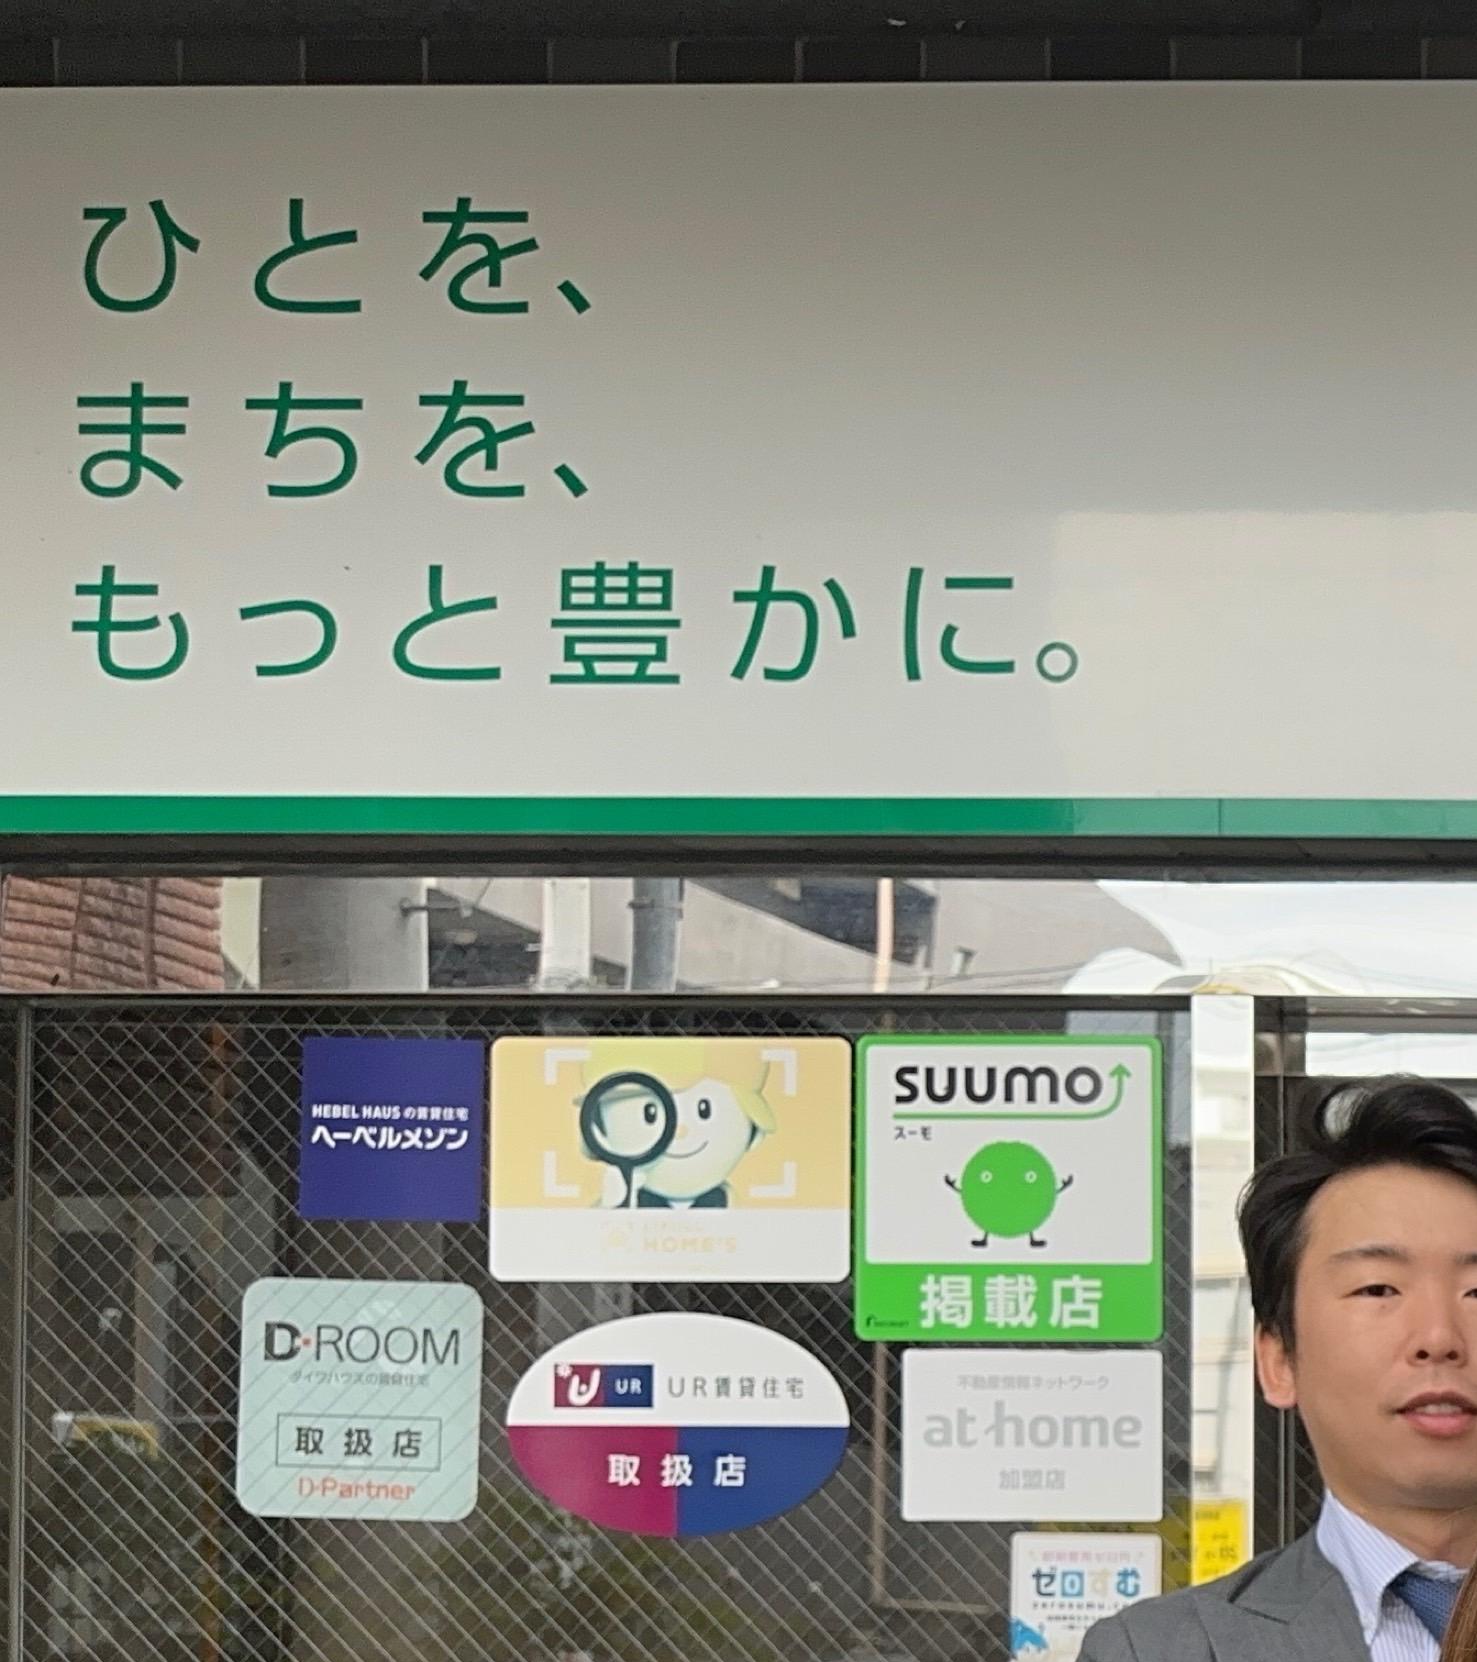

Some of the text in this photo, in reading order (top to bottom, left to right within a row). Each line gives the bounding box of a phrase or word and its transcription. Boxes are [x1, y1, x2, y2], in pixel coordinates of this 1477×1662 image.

[82, 196, 593, 315] ひとを、
[76, 379, 590, 498] まちを、
[71, 560, 1080, 686] もっと豊かに。
[311, 1103, 360, 1120] HEBEL
[361, 1104, 401, 1120] HAUS
[311, 1124, 469, 1150] ヘーベルメゾン
[893, 1125, 933, 1141] スーモ
[919, 1273, 1103, 1329] 掲載店
[614, 1377, 642, 1395] UR
[667, 1376, 805, 1400] UR賃貸住宅
[294, 1426, 423, 1459] 取扱店
[607, 1453, 747, 1488] 取扱店
[998, 1469, 1066, 1491] 加盟店
